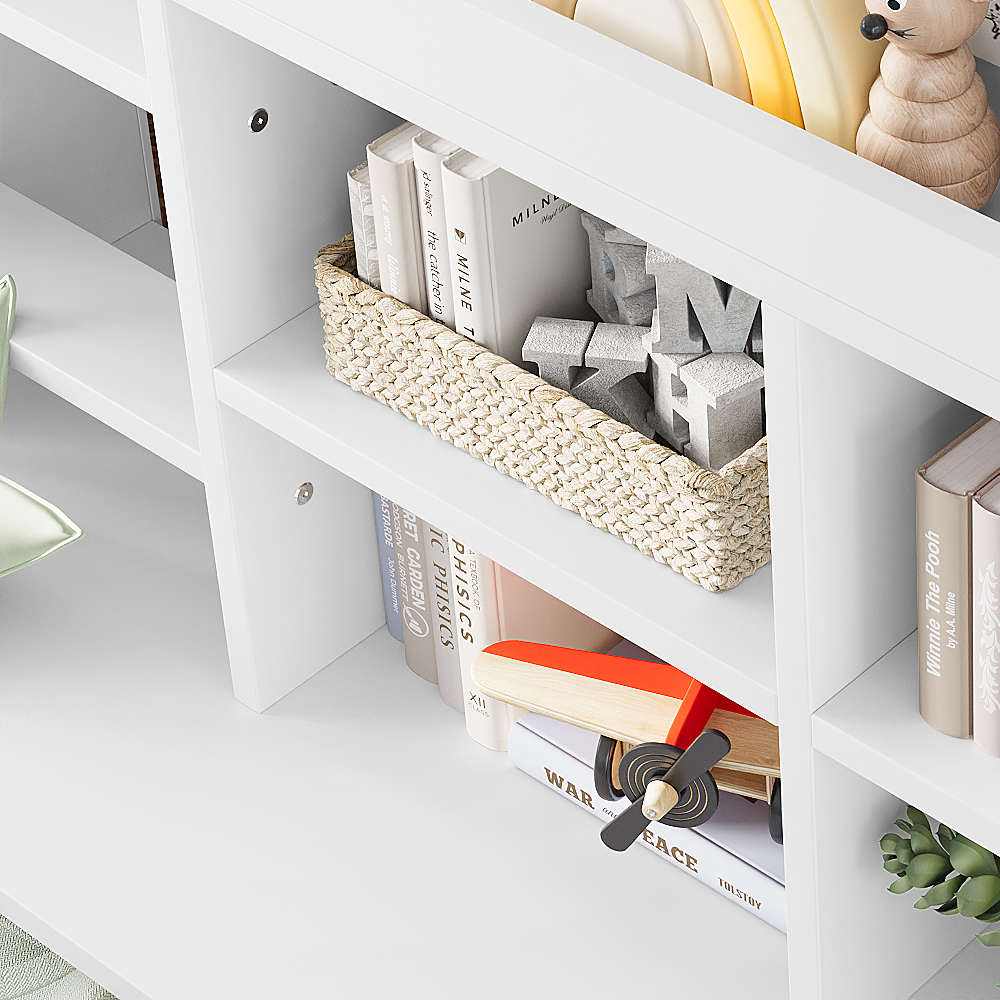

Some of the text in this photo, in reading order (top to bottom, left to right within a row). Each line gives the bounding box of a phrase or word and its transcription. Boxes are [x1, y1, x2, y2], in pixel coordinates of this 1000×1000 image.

[427, 230, 440, 251] the
[429, 253, 444, 302] catcher
[456, 253, 473, 312] MILNE
[397, 553, 410, 602] BURNETT
[406, 547, 426, 611] GARDEN
[433, 561, 455, 651] PHISICS
[451, 538, 475, 645] PHISICS
[924, 530, 941, 678] Winnie The Pooh
[945, 591, 959, 649] by A.A. Milne
[469, 691, 486, 709] XII
[543, 766, 595, 810] WAR
[642, 828, 699, 874] EACE
[717, 876, 762, 910] TOLSTOY
